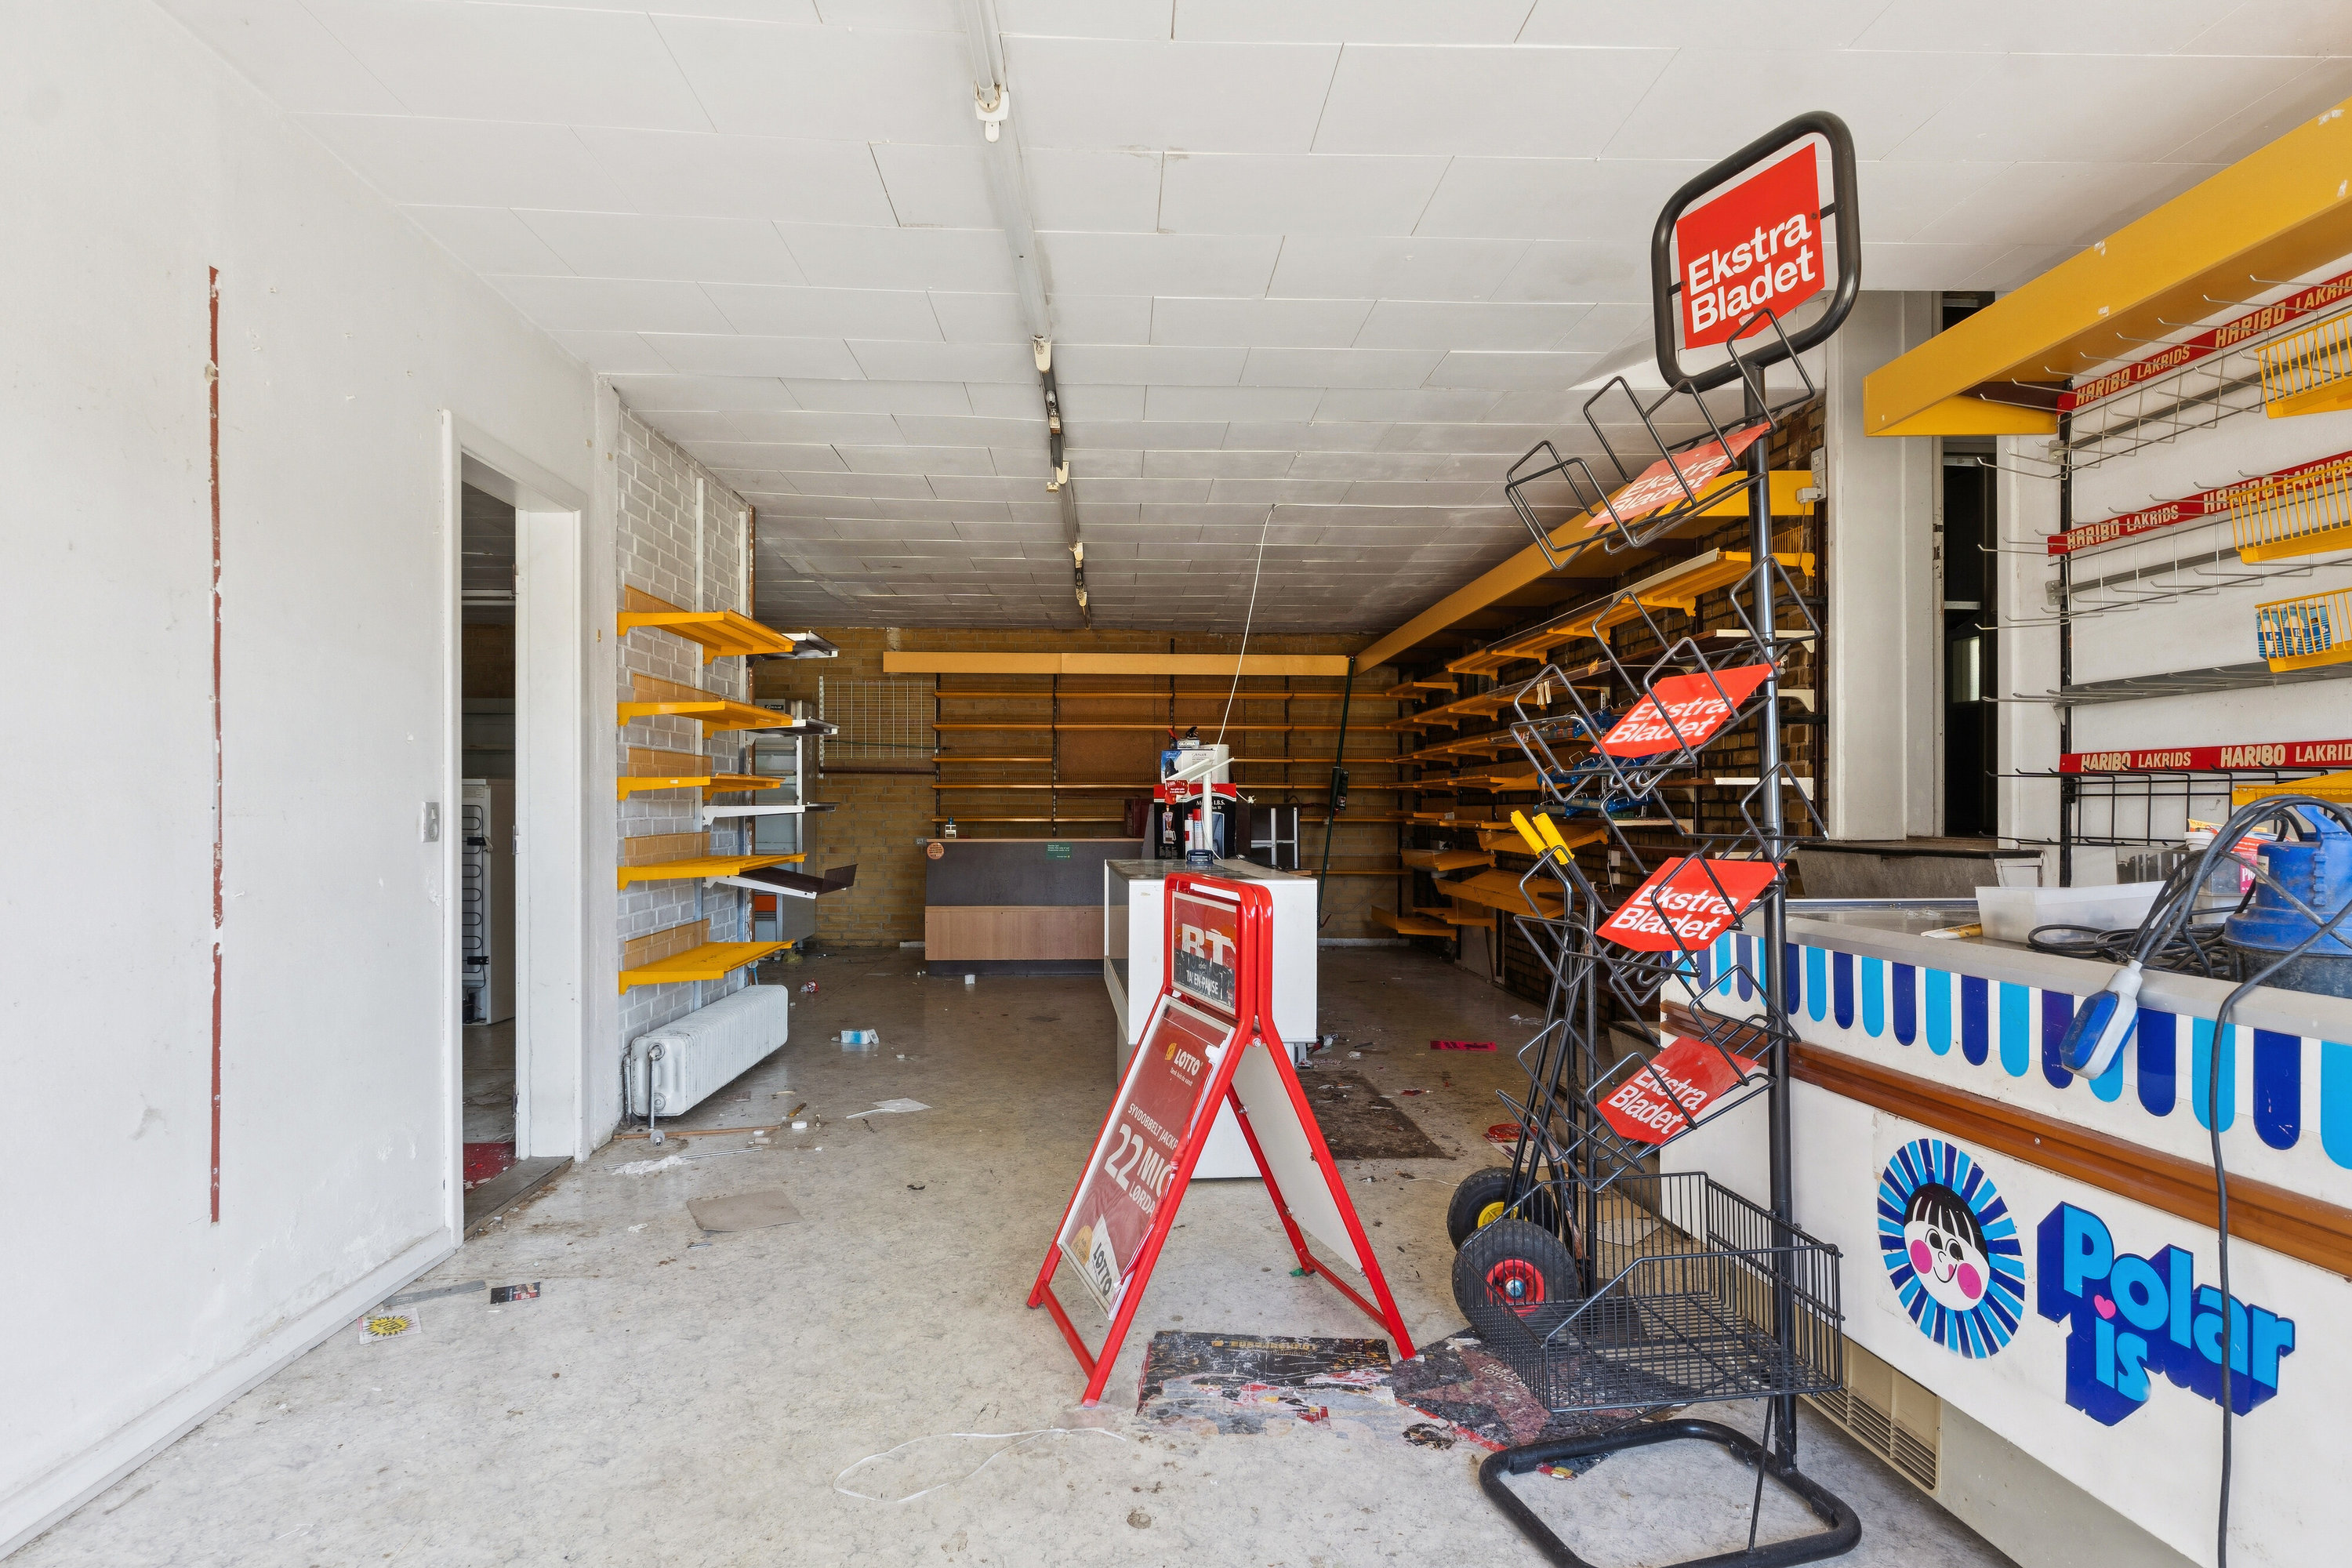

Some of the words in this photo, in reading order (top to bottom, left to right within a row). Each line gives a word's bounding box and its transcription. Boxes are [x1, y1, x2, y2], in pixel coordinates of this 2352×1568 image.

[1688, 213, 1812, 296] Ekstra
[1690, 245, 1816, 334] Bladet
[2215, 301, 2286, 348] HARIBO
[2076, 368, 2131, 407] HARIBO
[2136, 345, 2190, 379] LAKRIDS
[1598, 470, 1714, 519] Bladet
[1621, 454, 1729, 499] Ekstra
[2067, 519, 2120, 550] HARIBO
[2126, 504, 2179, 532] LAKRIDS
[2203, 476, 2274, 514] HARIBO
[2282, 456, 2352, 490] LAKRIDS
[1604, 715, 1717, 744] Bladet
[1625, 696, 1733, 722] Ekstra
[2081, 752, 2132, 772] HARIBO
[2138, 751, 2191, 768] LAKRIDS
[2220, 744, 2286, 768] HARIBO
[1610, 906, 1722, 940] Bladet
[1632, 884, 1739, 916] Ekstra
[1174, 1048, 1200, 1076] LOTTO
[1607, 1084, 1684, 1134] Bladet
[1633, 1063, 1708, 1111] Ekstra
[1127, 1102, 1163, 1141] SYVDOBBELT
[1104, 1123, 1144, 1192] 22
[1093, 1242, 1112, 1297] LOTTO
[2048, 1203, 2295, 1402] Polar
[1479, 1367, 1514, 1381] LOTTO
